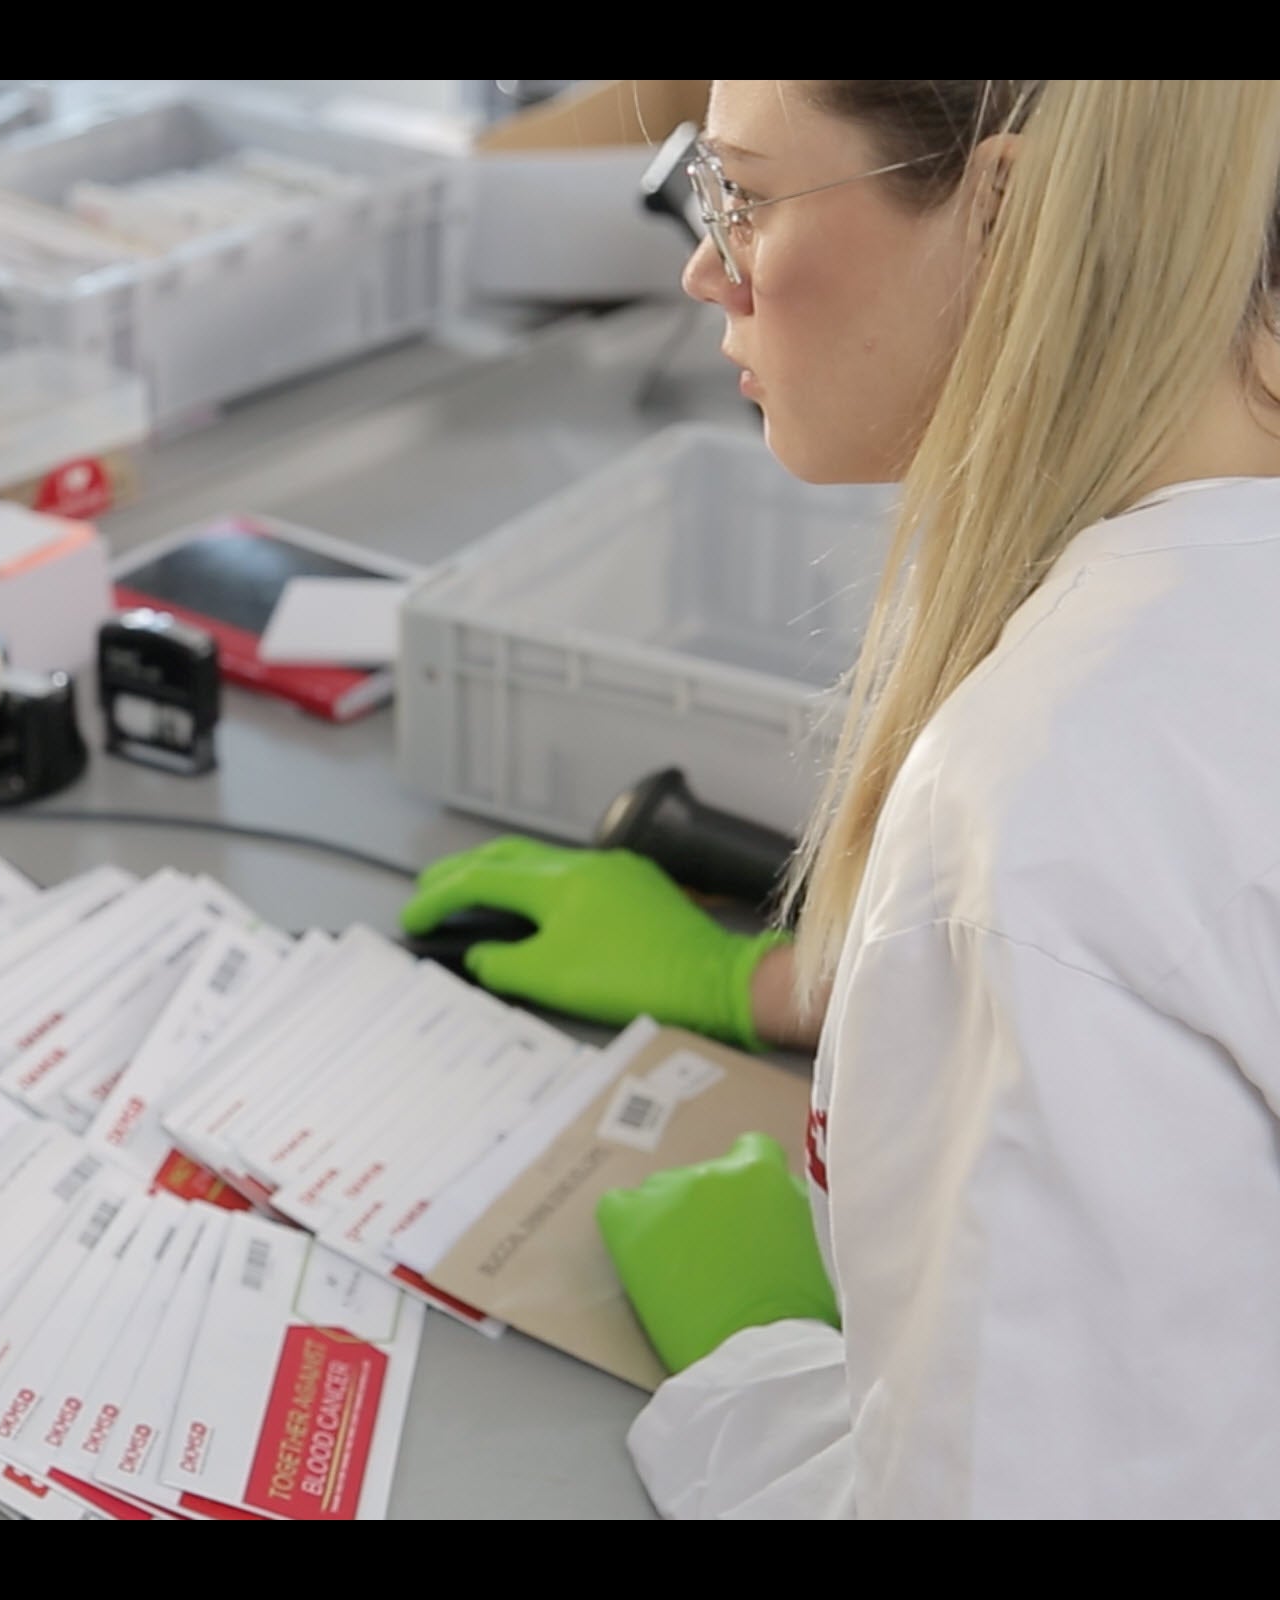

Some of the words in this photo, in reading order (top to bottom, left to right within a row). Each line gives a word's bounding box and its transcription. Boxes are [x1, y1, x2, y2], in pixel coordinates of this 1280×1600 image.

[316, 1360, 351, 1429] CANCER
[45, 1403, 79, 1446] DKMS
[82, 1410, 116, 1454] DKMS
[268, 1409, 310, 1501] TOGETHER
[292, 1338, 327, 1408] AGAINST
[118, 1430, 149, 1473] DKMS
[180, 1428, 205, 1473] DKMS
[301, 1430, 336, 1496] BLOOD
